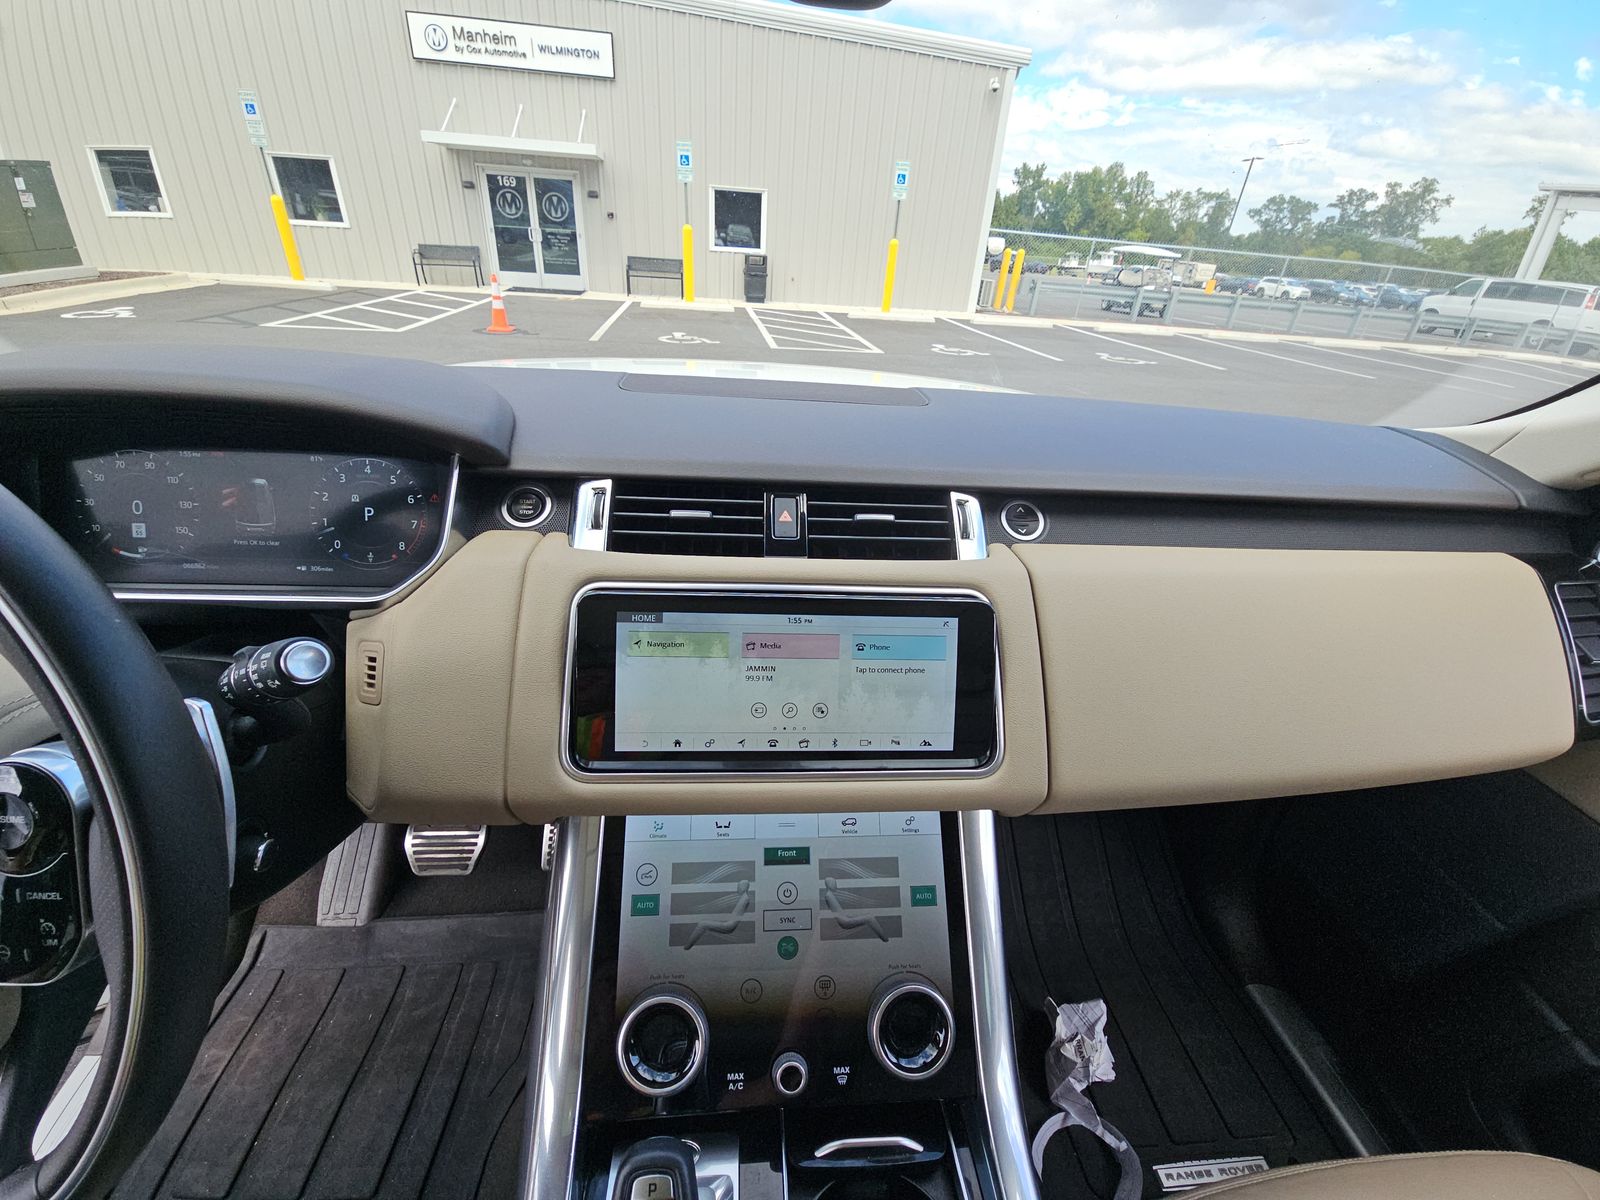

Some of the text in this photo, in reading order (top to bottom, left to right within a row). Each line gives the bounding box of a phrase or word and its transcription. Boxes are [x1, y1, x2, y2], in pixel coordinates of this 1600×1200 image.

[452, 26, 517, 46] Manheim
[455, 45, 528, 59] by Cox Automotive
[537, 43, 600, 60] WILMINGTON
[497, 176, 516, 187] 169
[115, 460, 126, 469] 70
[144, 461, 155, 470] 90
[364, 466, 371, 474] 4
[94, 473, 105, 482] 50
[167, 476, 179, 484] 110
[339, 474, 346, 482] 3
[390, 475, 397, 484] 5
[322, 492, 328, 501] 2
[407, 495, 414, 504] 6
[85, 498, 94, 506] 30
[179, 500, 192, 509] 130
[131, 500, 143, 514] 0
[364, 507, 375, 521] P
[323, 518, 328, 526] 1
[411, 520, 418, 529] 7
[92, 524, 100, 532] 10
[175, 526, 188, 534] 150
[334, 540, 341, 548] 0
[399, 542, 405, 550] 8
[632, 614, 656, 622] HOME
[647, 641, 685, 649] Navigation
[869, 643, 891, 651] Phone
[856, 666, 867, 674] Tap
[877, 666, 904, 674] connect
[904, 666, 926, 675] phone
[778, 849, 797, 857] Front
[26, 892, 63, 900] CANCEL
[637, 901, 654, 909] AUTO
[833, 1066, 850, 1074] MAX
[728, 1082, 744, 1090] A/C
[648, 1183, 657, 1197] P
